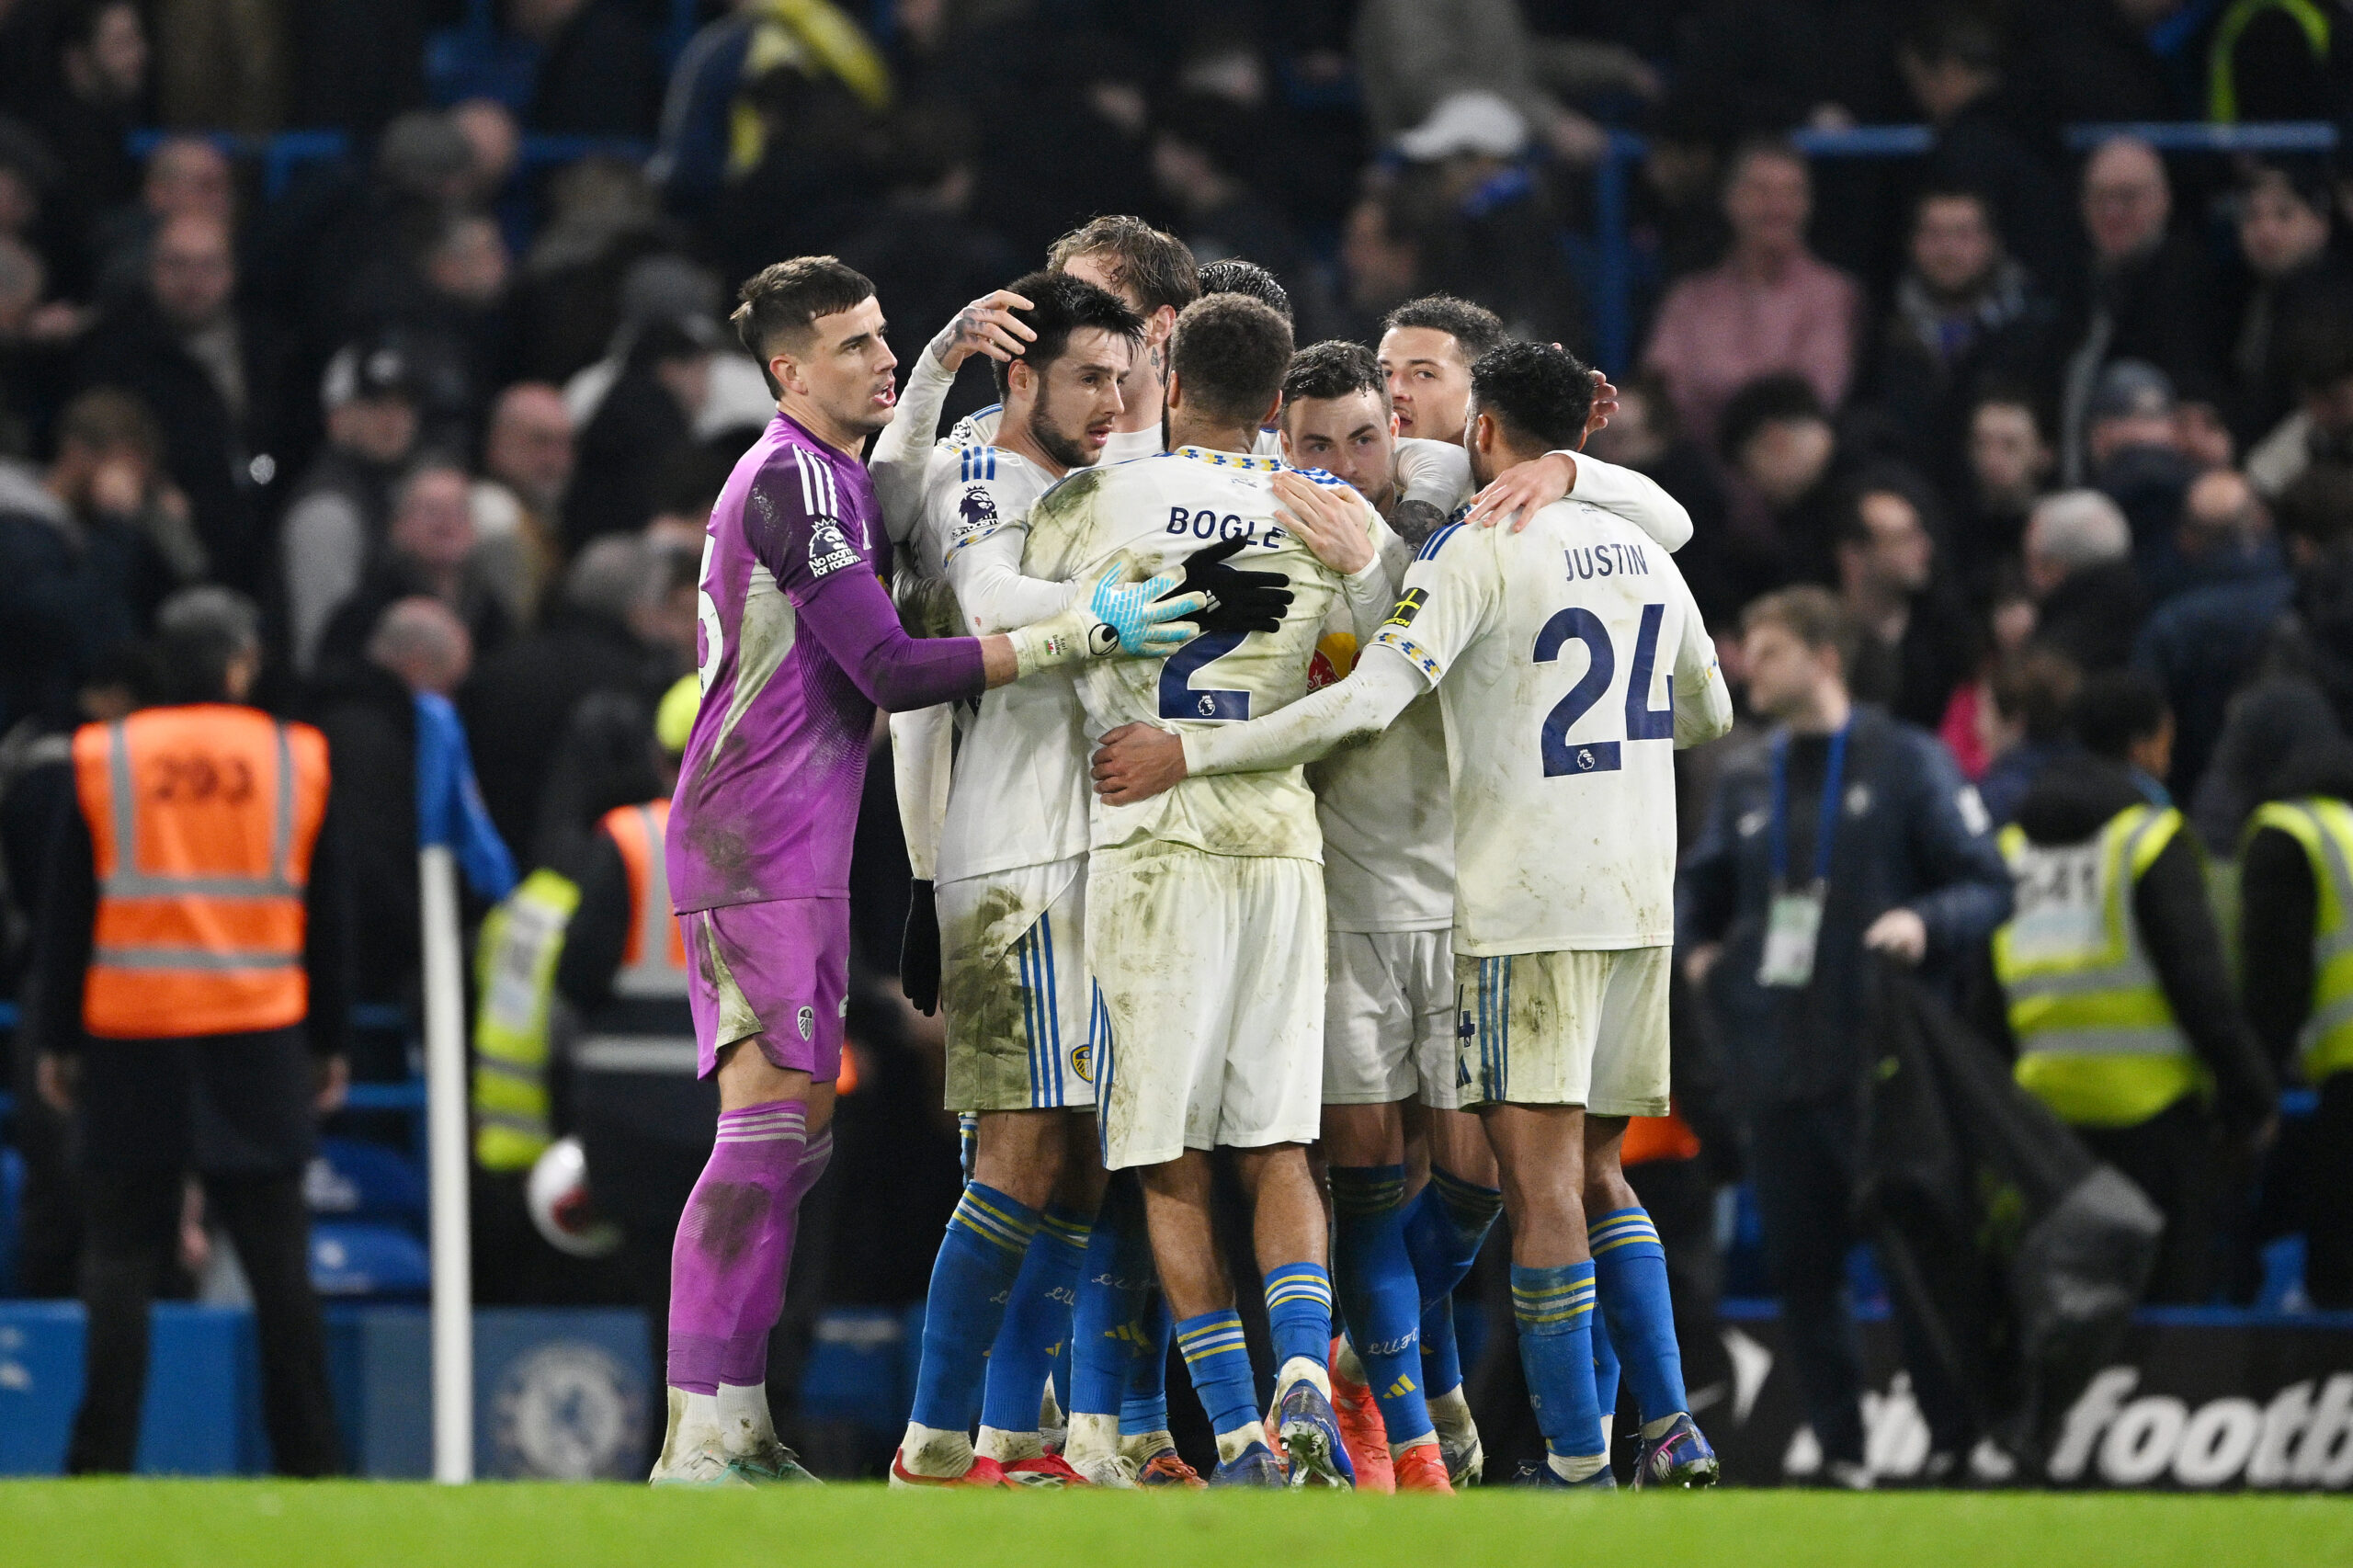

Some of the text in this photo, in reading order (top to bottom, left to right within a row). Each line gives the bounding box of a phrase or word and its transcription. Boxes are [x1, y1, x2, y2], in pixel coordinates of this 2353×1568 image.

[1165, 506, 1287, 549] BOGLE
[825, 548, 854, 562] room
[828, 554, 861, 571] racism
[1563, 543, 1649, 582] JUSTIN
[1158, 629, 1251, 722] 2
[1532, 603, 1675, 778] 24
